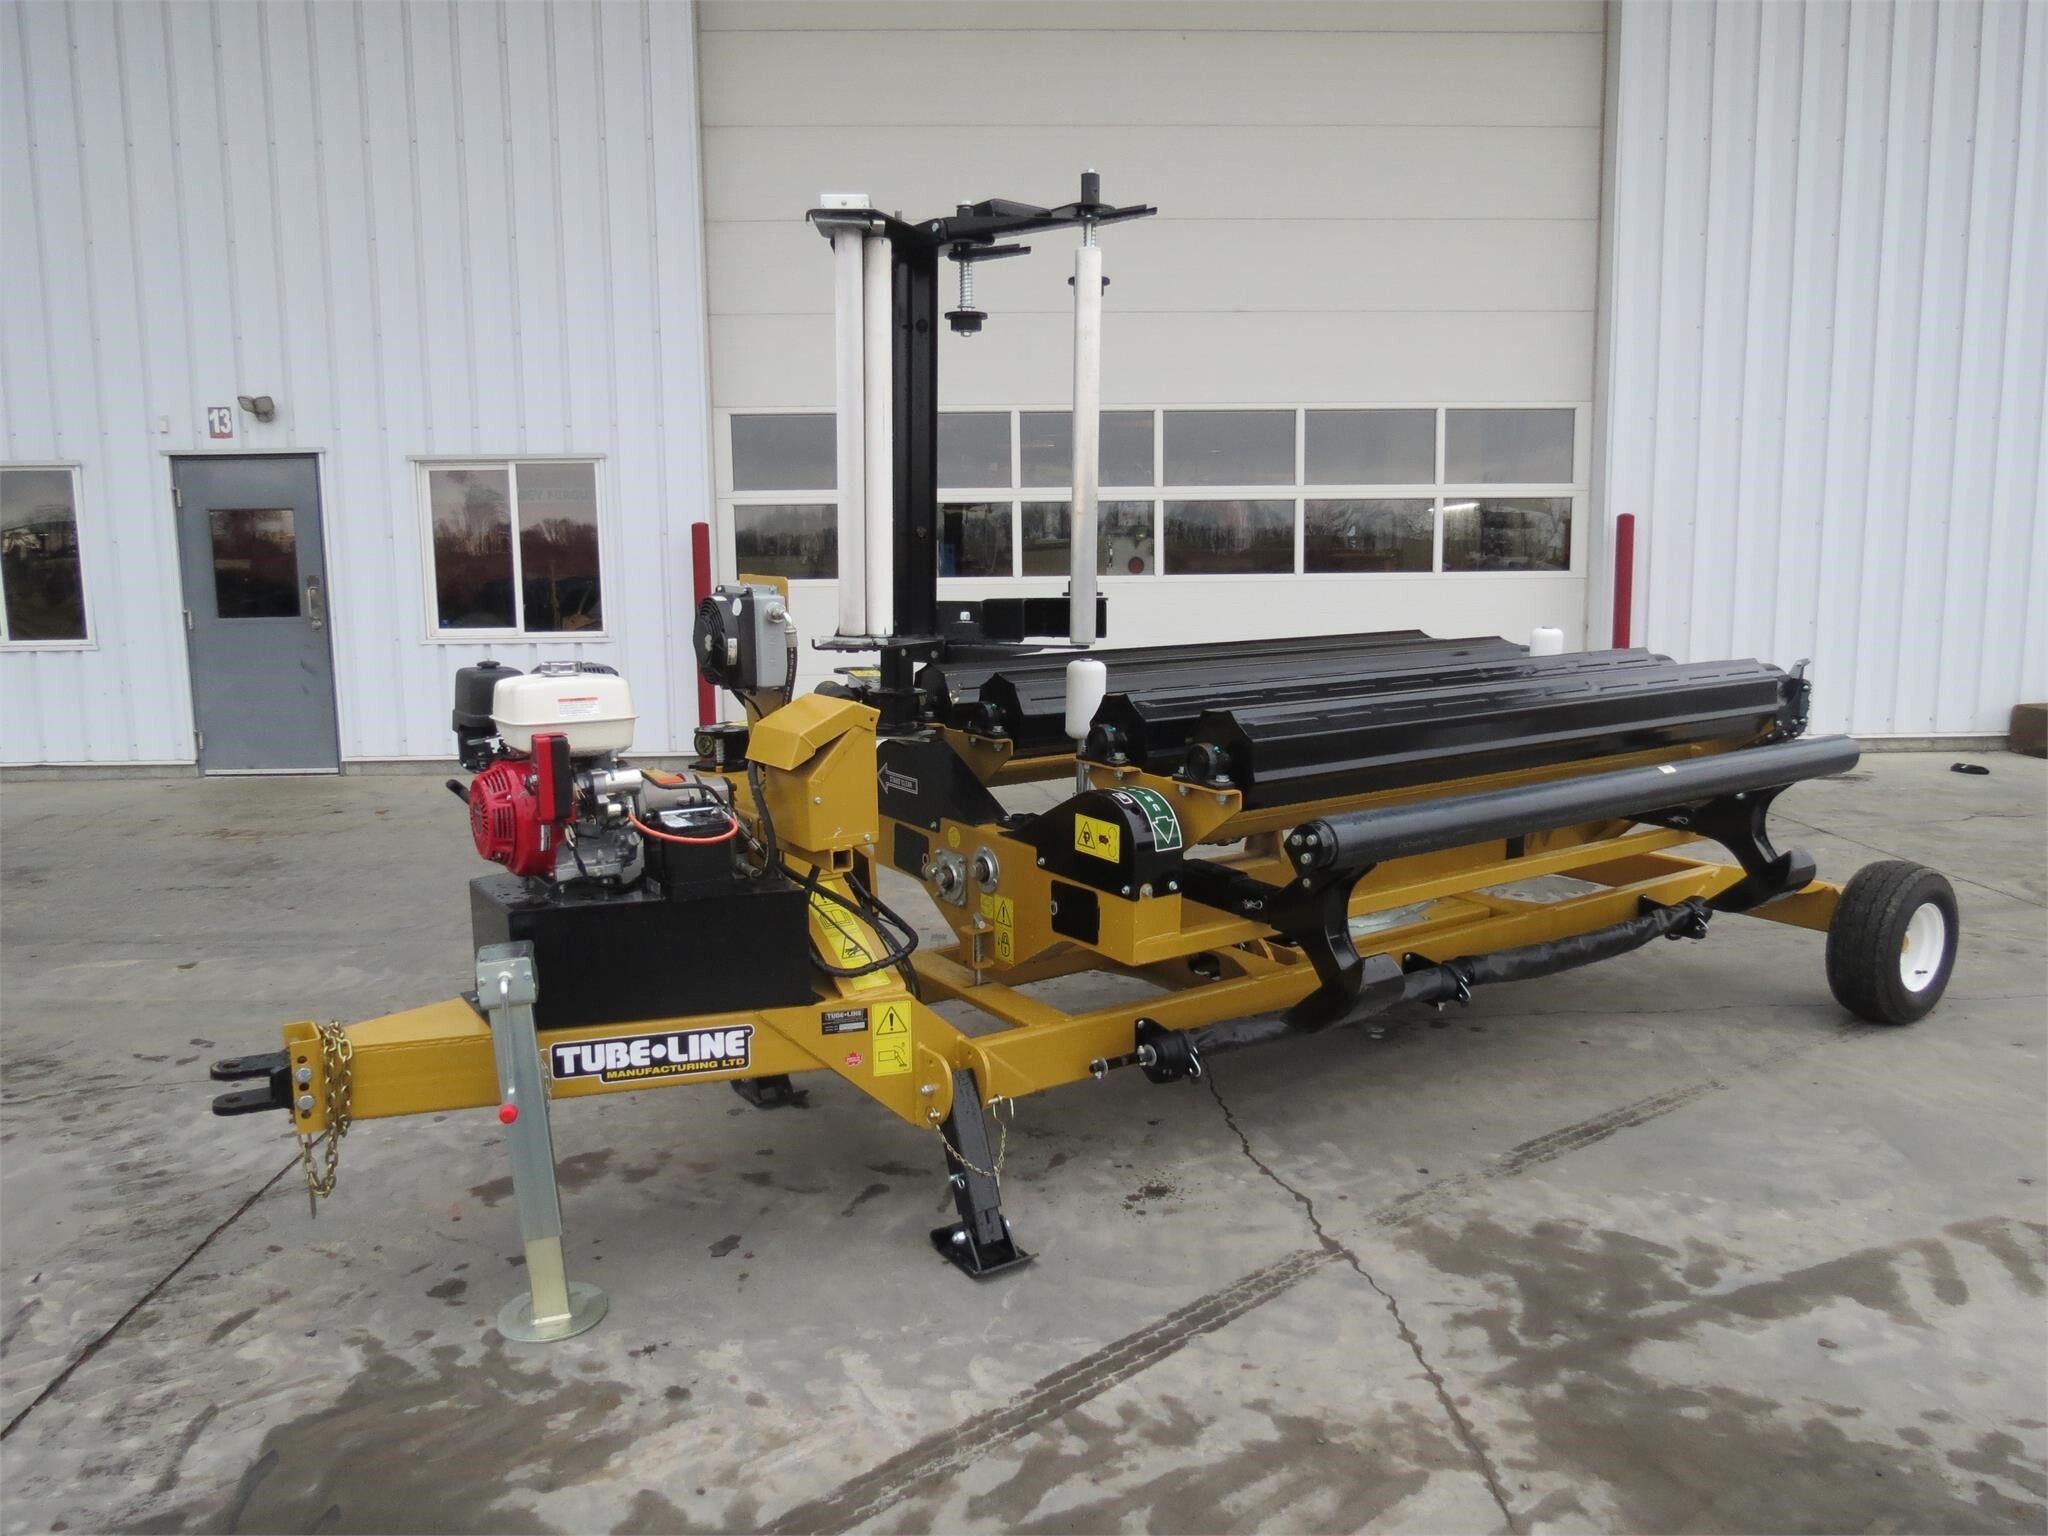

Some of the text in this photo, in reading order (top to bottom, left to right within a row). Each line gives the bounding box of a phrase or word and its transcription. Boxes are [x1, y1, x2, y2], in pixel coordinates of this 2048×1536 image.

[210, 409, 231, 433] 13
[607, 1058, 745, 1079] MANUFACTURING LTD
